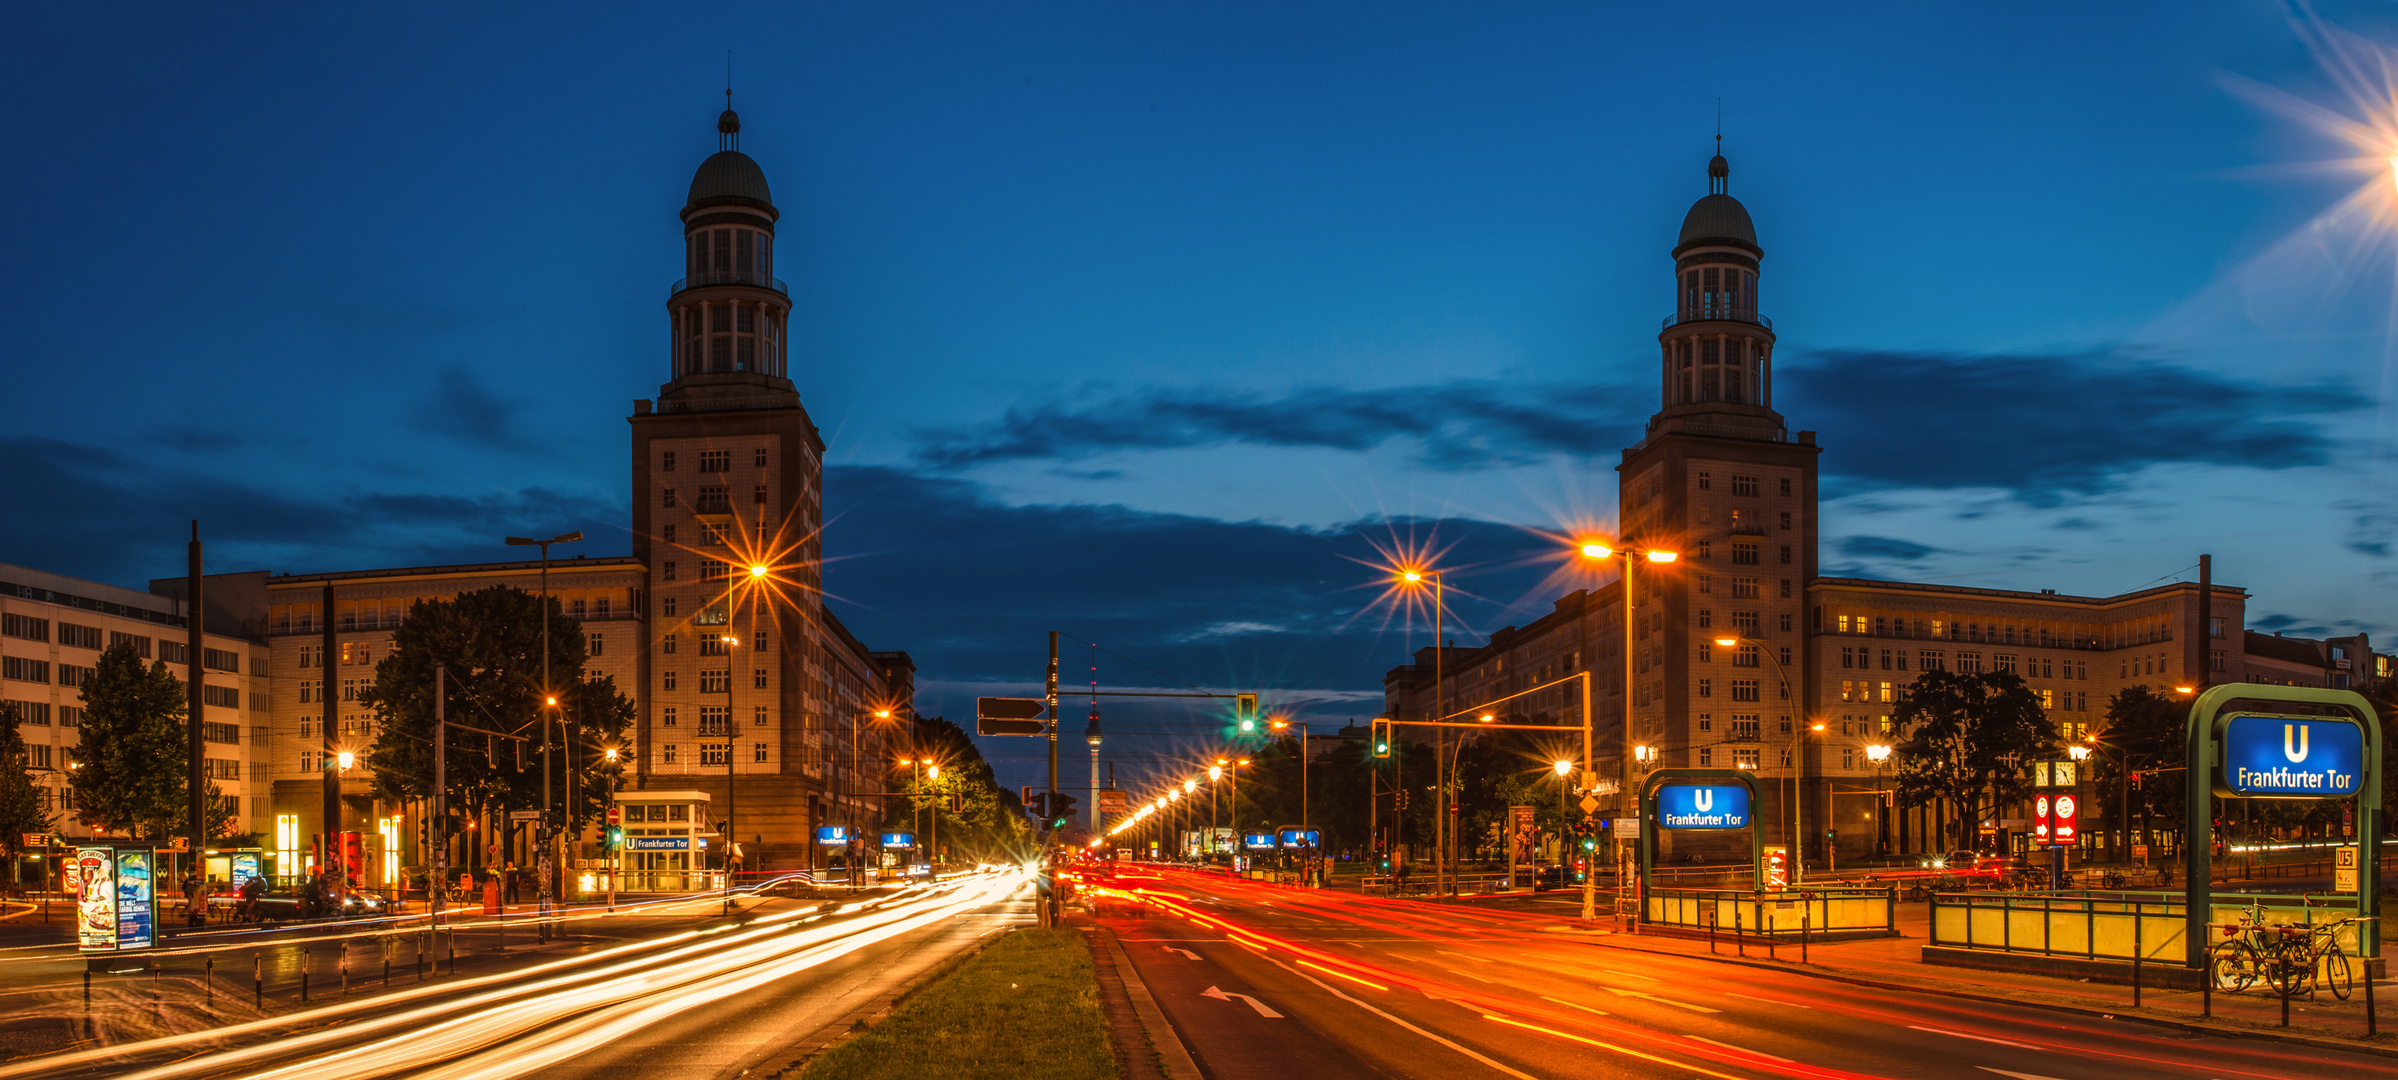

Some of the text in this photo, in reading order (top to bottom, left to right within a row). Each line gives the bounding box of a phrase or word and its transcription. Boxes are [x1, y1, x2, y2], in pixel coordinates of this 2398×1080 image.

[2285, 724, 2308, 763] U
[2239, 767, 2351, 788] Frankfurter Tor
[1695, 789, 1713, 812] U
[1666, 813, 1742, 825] Frankfurter Tor
[833, 828, 842, 838] U
[893, 834, 901, 843] U
[626, 838, 687, 850] U Frankfurter Tor
[1257, 835, 1264, 844] U
[2338, 851, 2351, 865] U5
